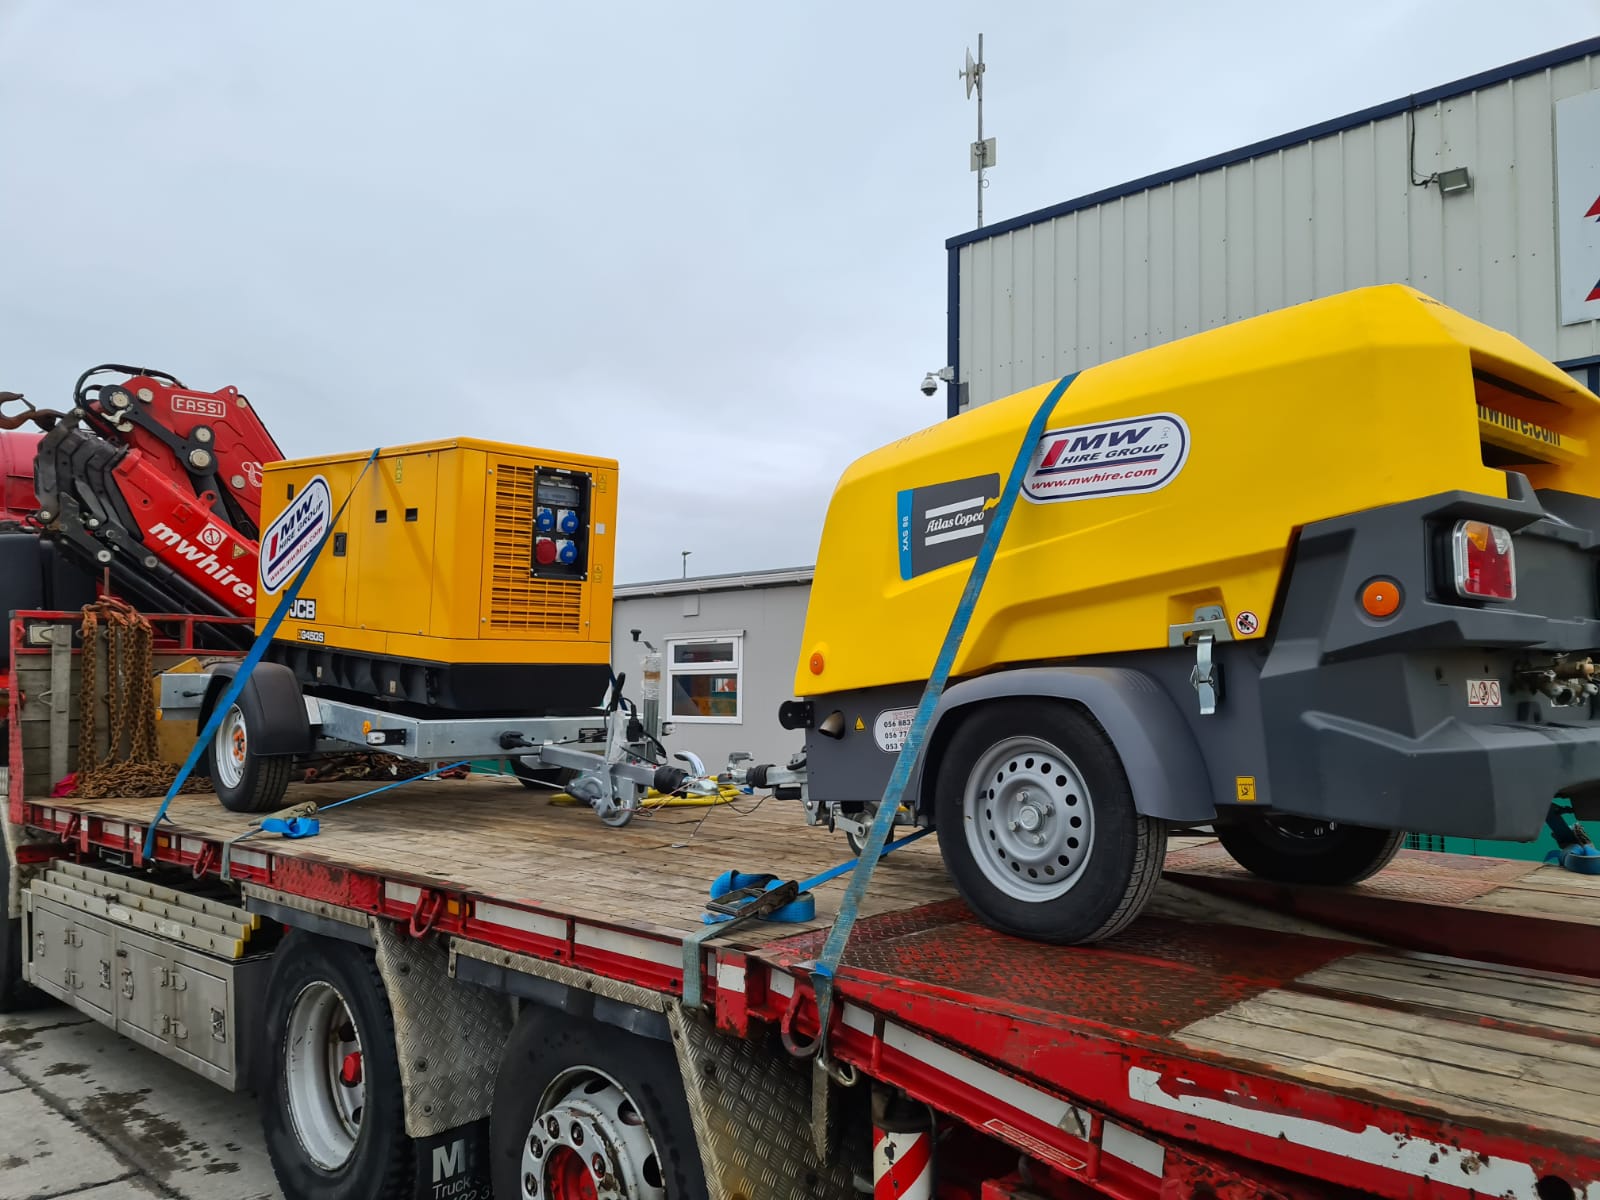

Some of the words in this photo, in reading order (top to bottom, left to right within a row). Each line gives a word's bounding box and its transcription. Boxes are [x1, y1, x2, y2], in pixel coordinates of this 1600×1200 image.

[175, 399, 223, 415] FASSI
[1069, 427, 1152, 453] MW
[1061, 451, 1102, 465] HIRE
[1105, 443, 1169, 459] GROUP
[1031, 468, 1158, 490] www.mwhire.com
[279, 531, 295, 552] HIRE
[297, 500, 323, 532] GROUP
[280, 494, 313, 540] MW
[925, 519, 954, 534] Atlas
[954, 511, 985, 526] Copco
[289, 599, 316, 619] JCB
[432, 1176, 471, 1200] Truck
